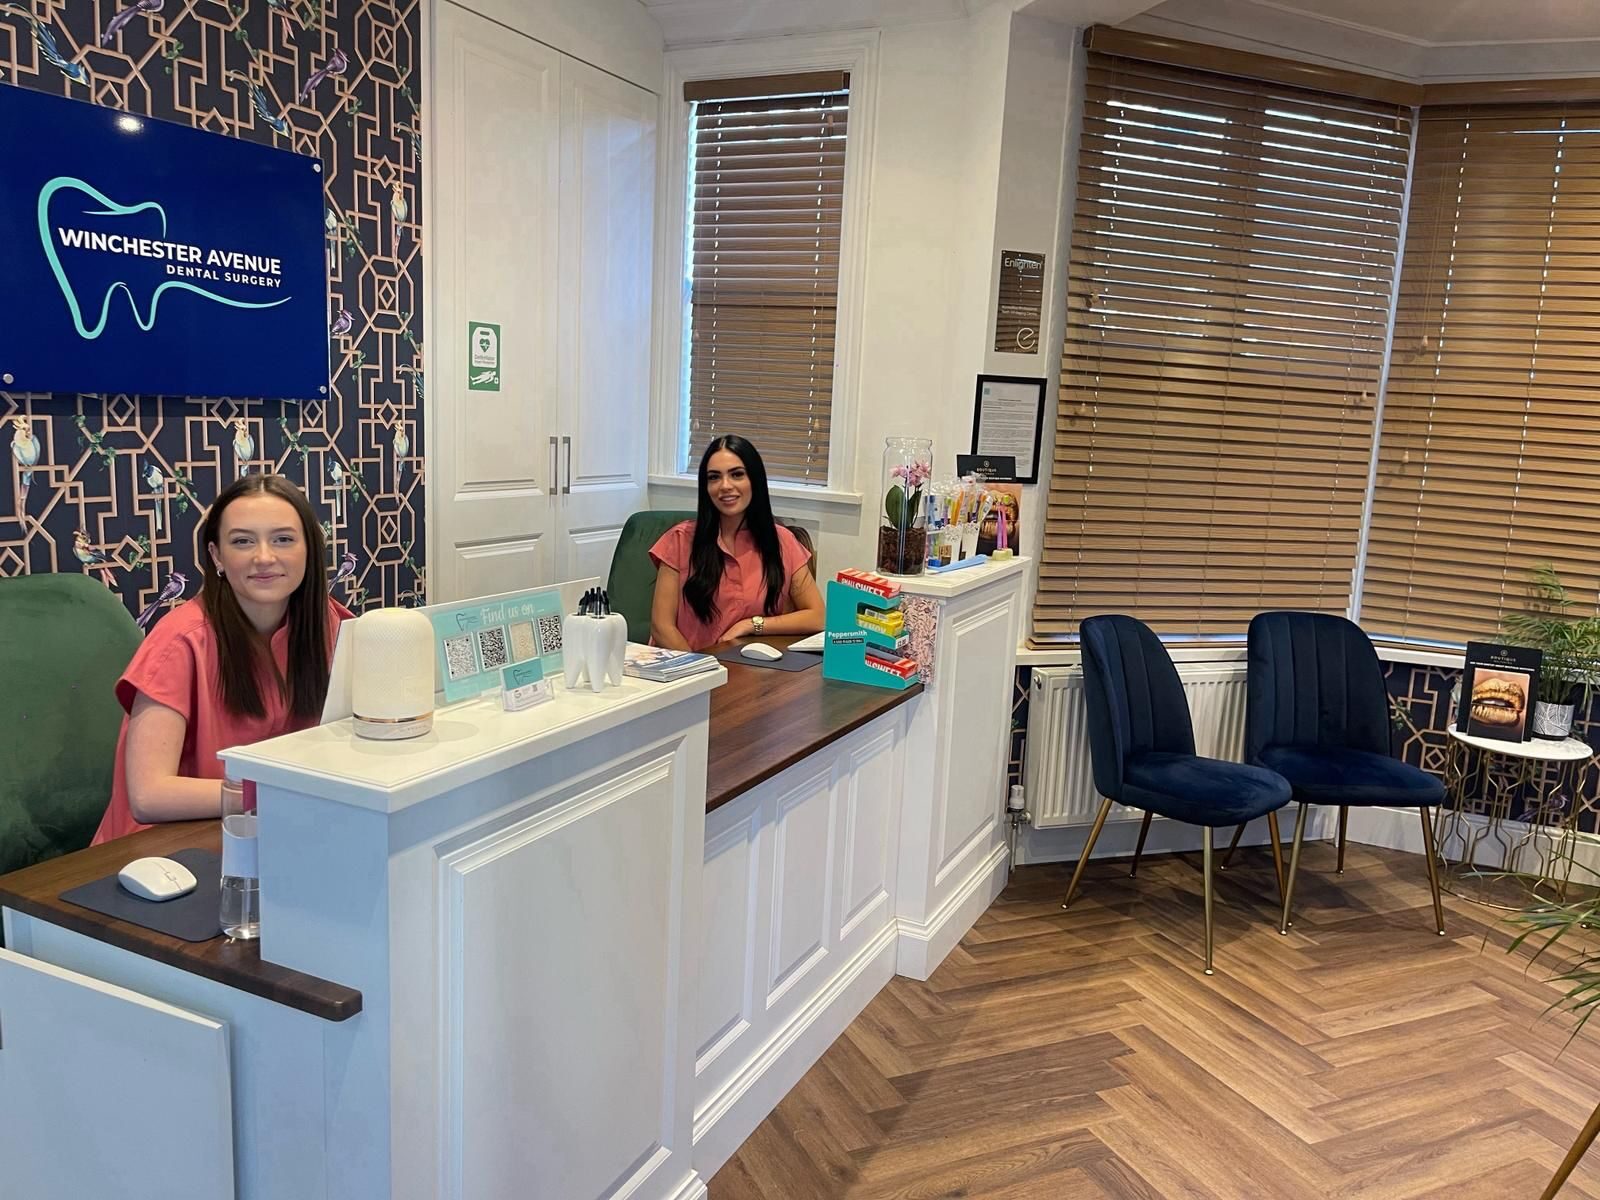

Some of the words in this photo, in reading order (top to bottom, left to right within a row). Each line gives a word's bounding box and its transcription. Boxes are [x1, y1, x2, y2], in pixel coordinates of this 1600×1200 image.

[58, 227, 202, 264] WINCHESTER
[207, 250, 281, 275] AVENUE
[1004, 257, 1042, 270] Enlighten
[166, 264, 220, 281] DENTAL
[224, 272, 282, 289] SURGERY
[855, 582, 885, 597] SWEET
[480, 602, 506, 625] Find
[508, 605, 519, 618] us
[521, 603, 534, 616] on
[828, 630, 868, 639] Peppersmith
[872, 662, 902, 677] SWEET
